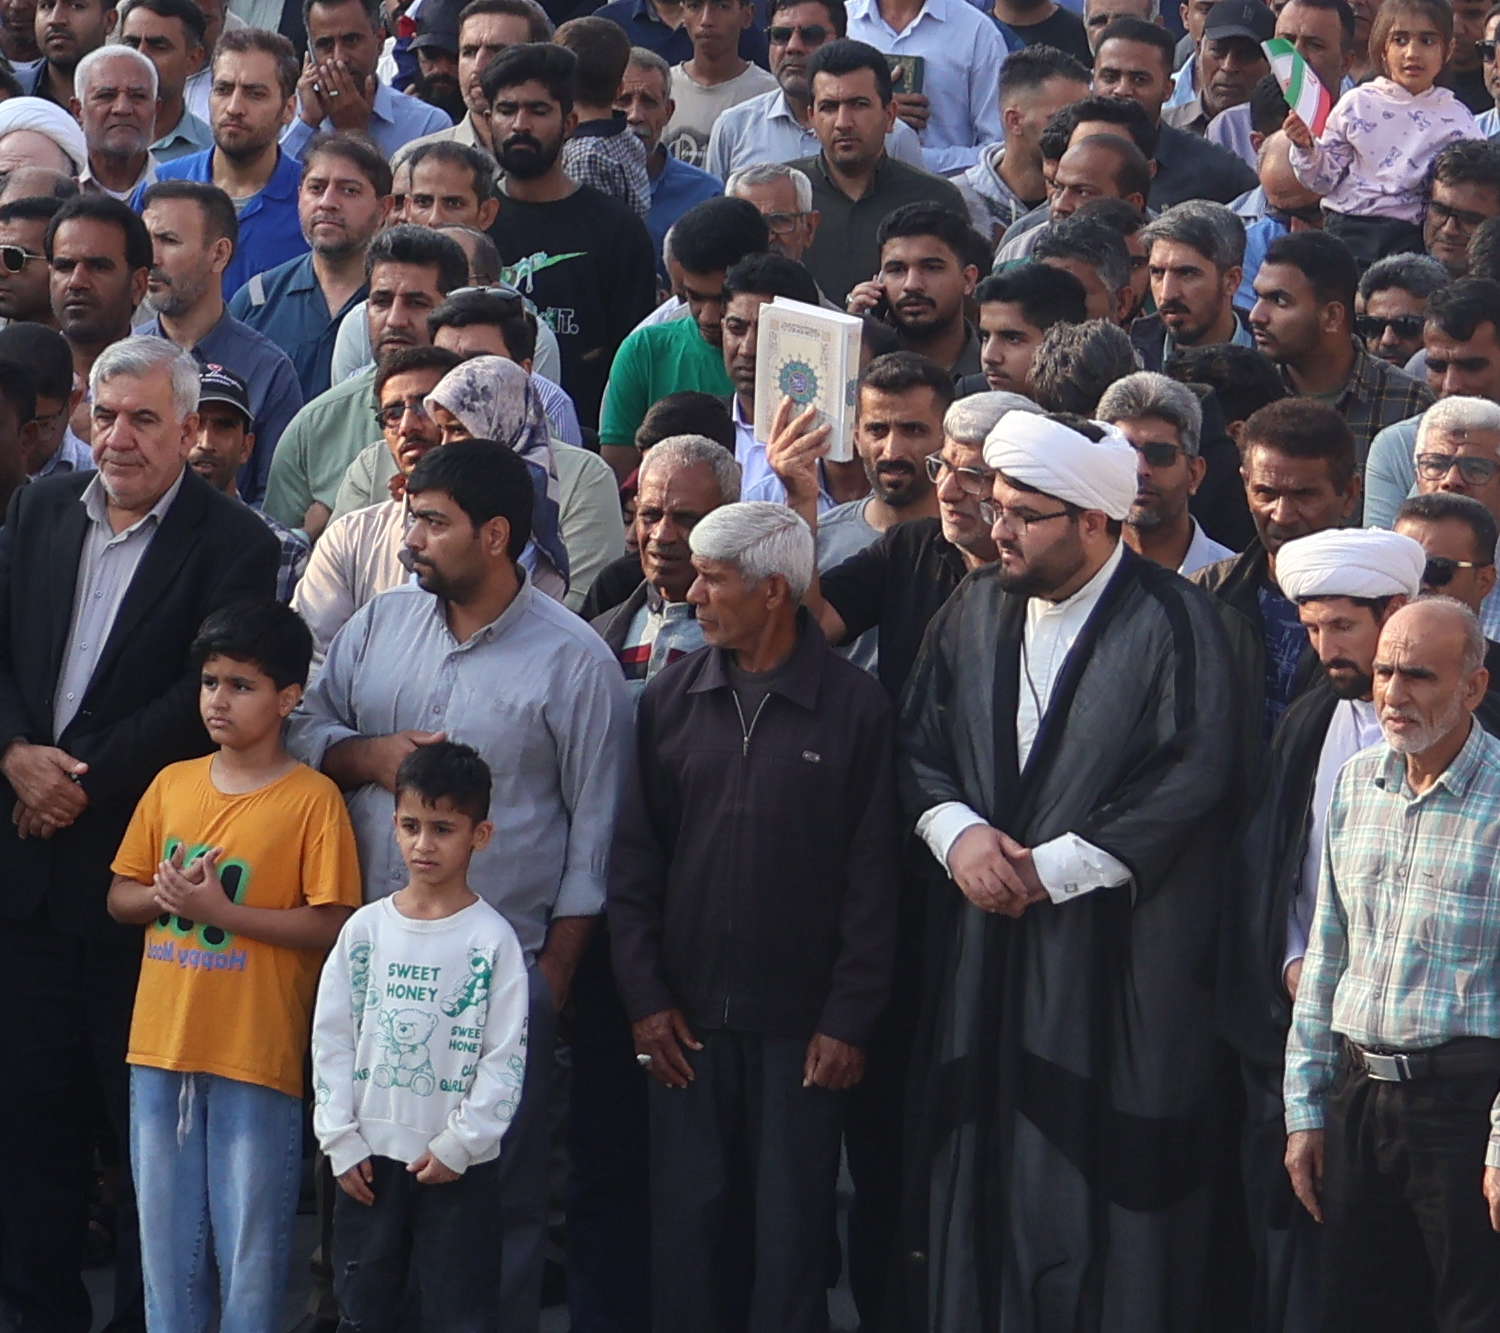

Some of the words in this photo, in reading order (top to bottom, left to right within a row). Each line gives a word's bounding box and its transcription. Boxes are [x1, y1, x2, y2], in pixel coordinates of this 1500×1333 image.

[388, 962, 442, 982] SWEET
[386, 984, 439, 1003] HONEY
[450, 1026, 482, 1040] SWEE
